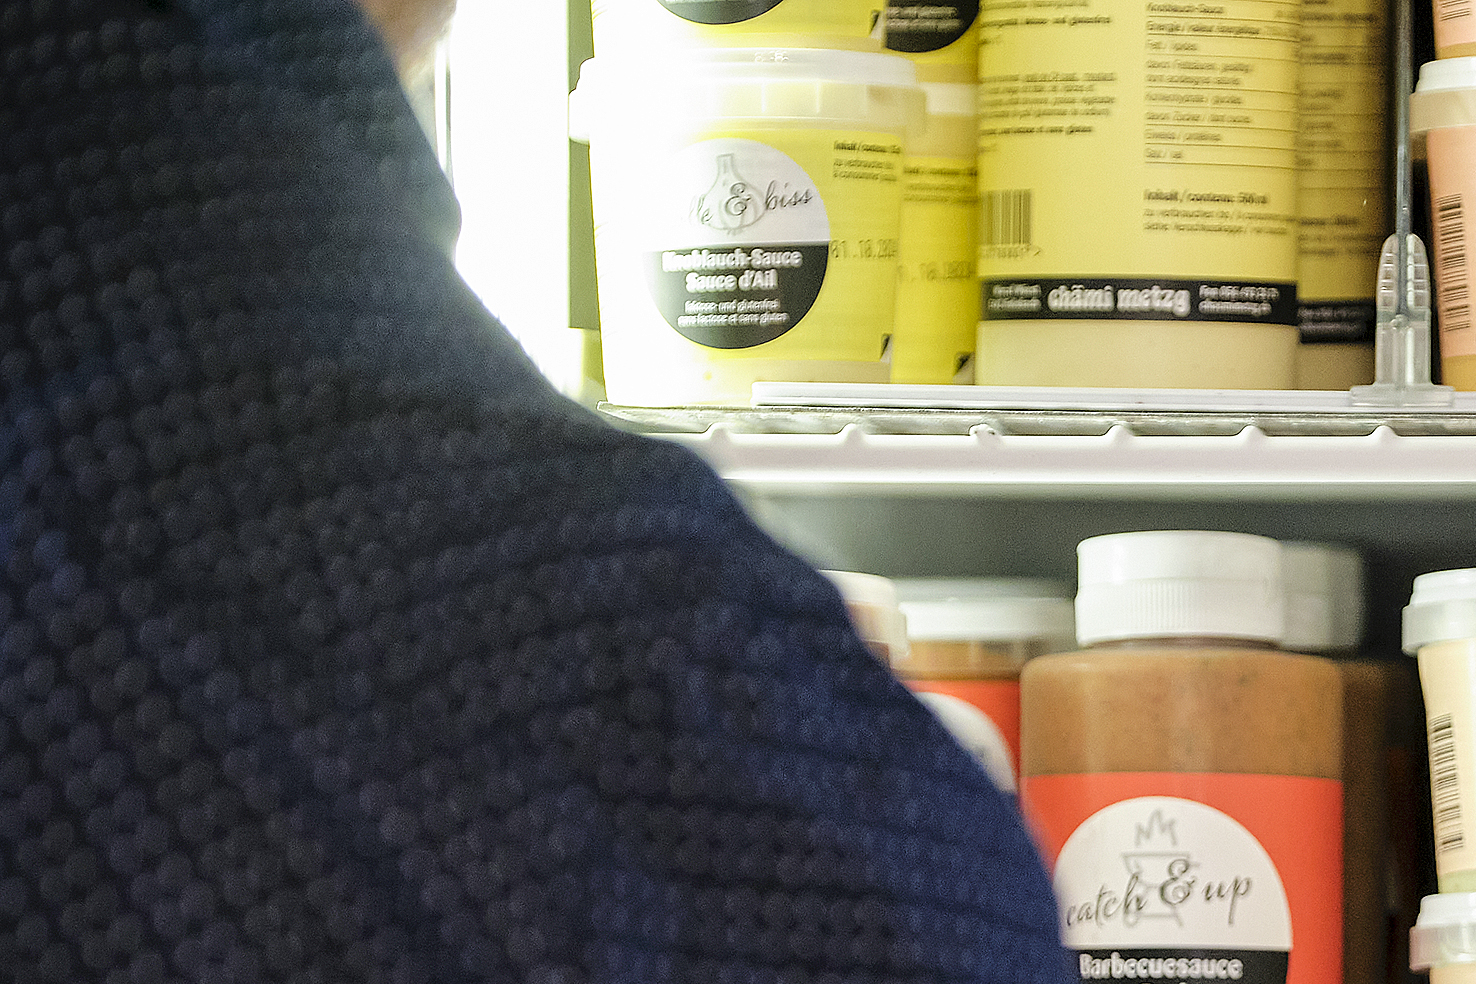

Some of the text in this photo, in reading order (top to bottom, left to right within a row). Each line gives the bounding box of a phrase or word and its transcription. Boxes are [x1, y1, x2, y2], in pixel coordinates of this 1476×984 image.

[725, 180, 813, 216] & biss
[662, 248, 803, 272] Knoblauch-Sauce
[686, 272, 737, 294] Sauce
[1049, 285, 1115, 311] chämi
[1117, 285, 1192, 316] metzg
[1067, 859, 1252, 927] catch & up
[1079, 952, 1244, 980] Barbecuesauce
